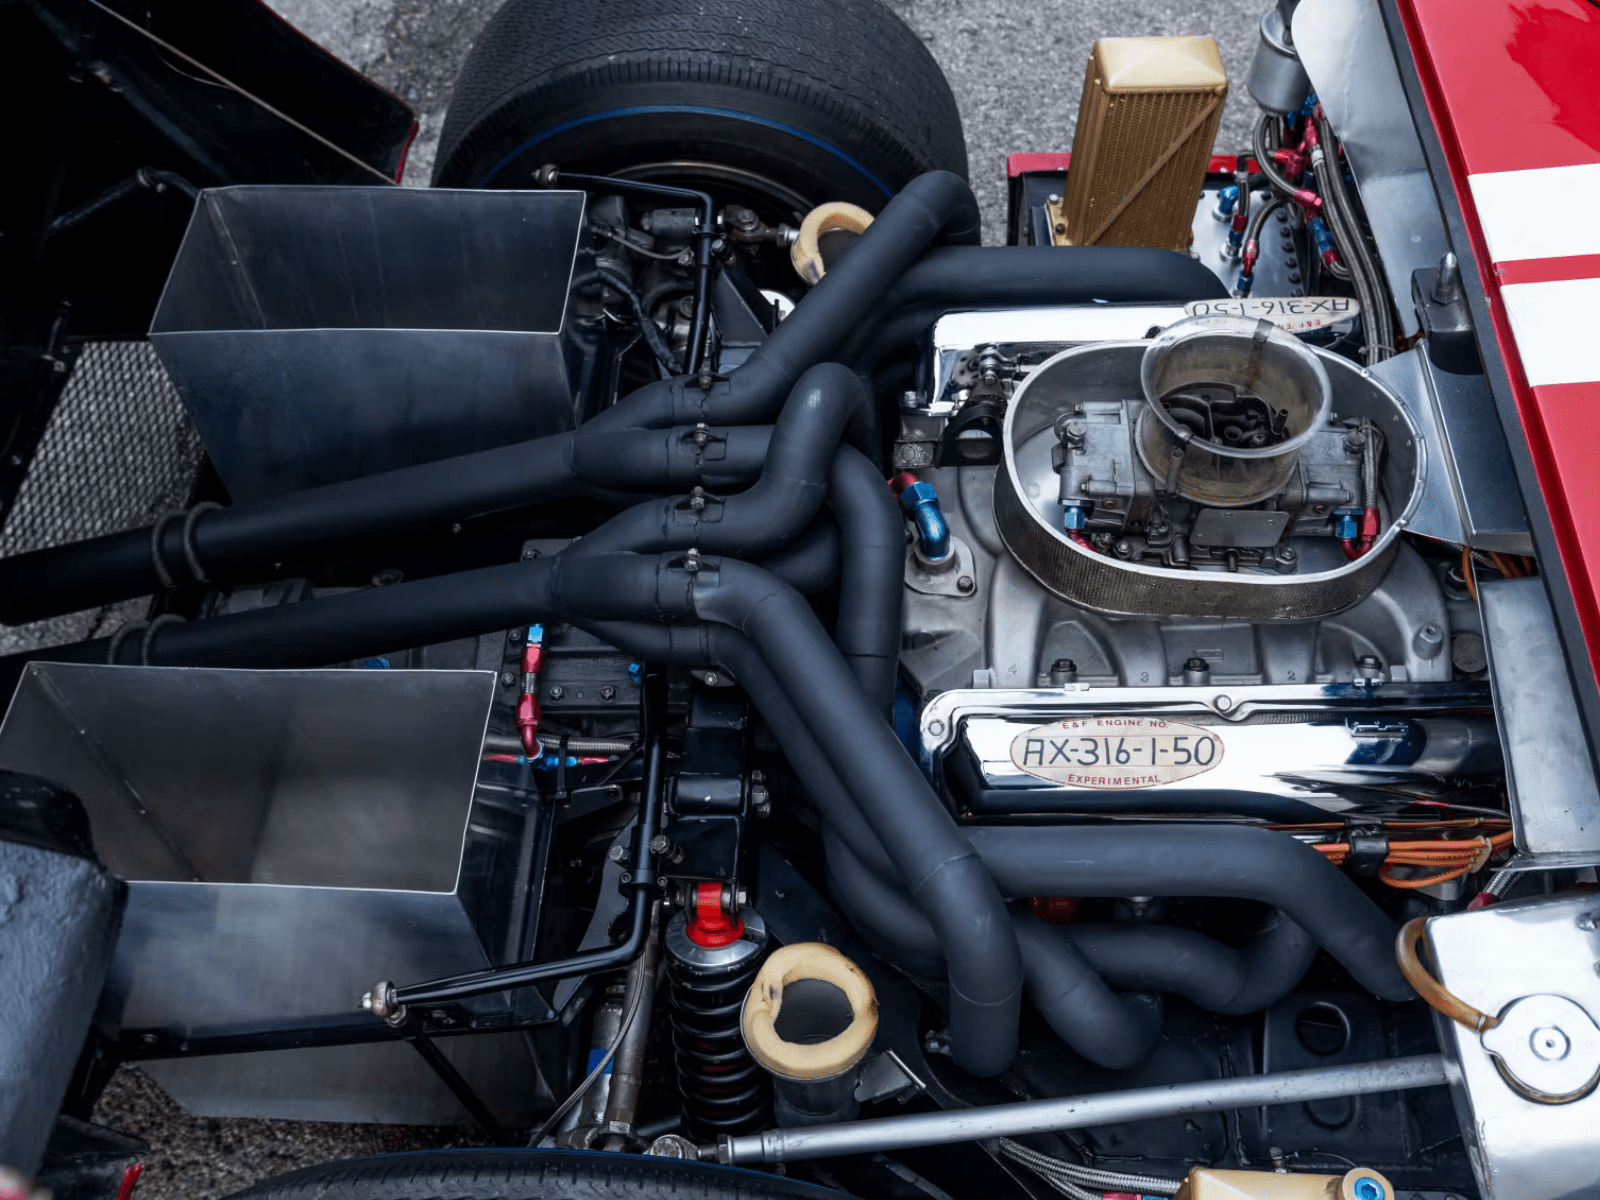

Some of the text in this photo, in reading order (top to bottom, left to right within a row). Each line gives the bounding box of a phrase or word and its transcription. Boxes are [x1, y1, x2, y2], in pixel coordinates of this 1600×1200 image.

[1141, 671, 1149, 683] 3
[1287, 670, 1296, 681] 2
[1097, 719, 1143, 727] ENGINE
[1022, 736, 1216, 766] AX-316-1-50
[1068, 774, 1161, 786] EXPERIMENTAL
